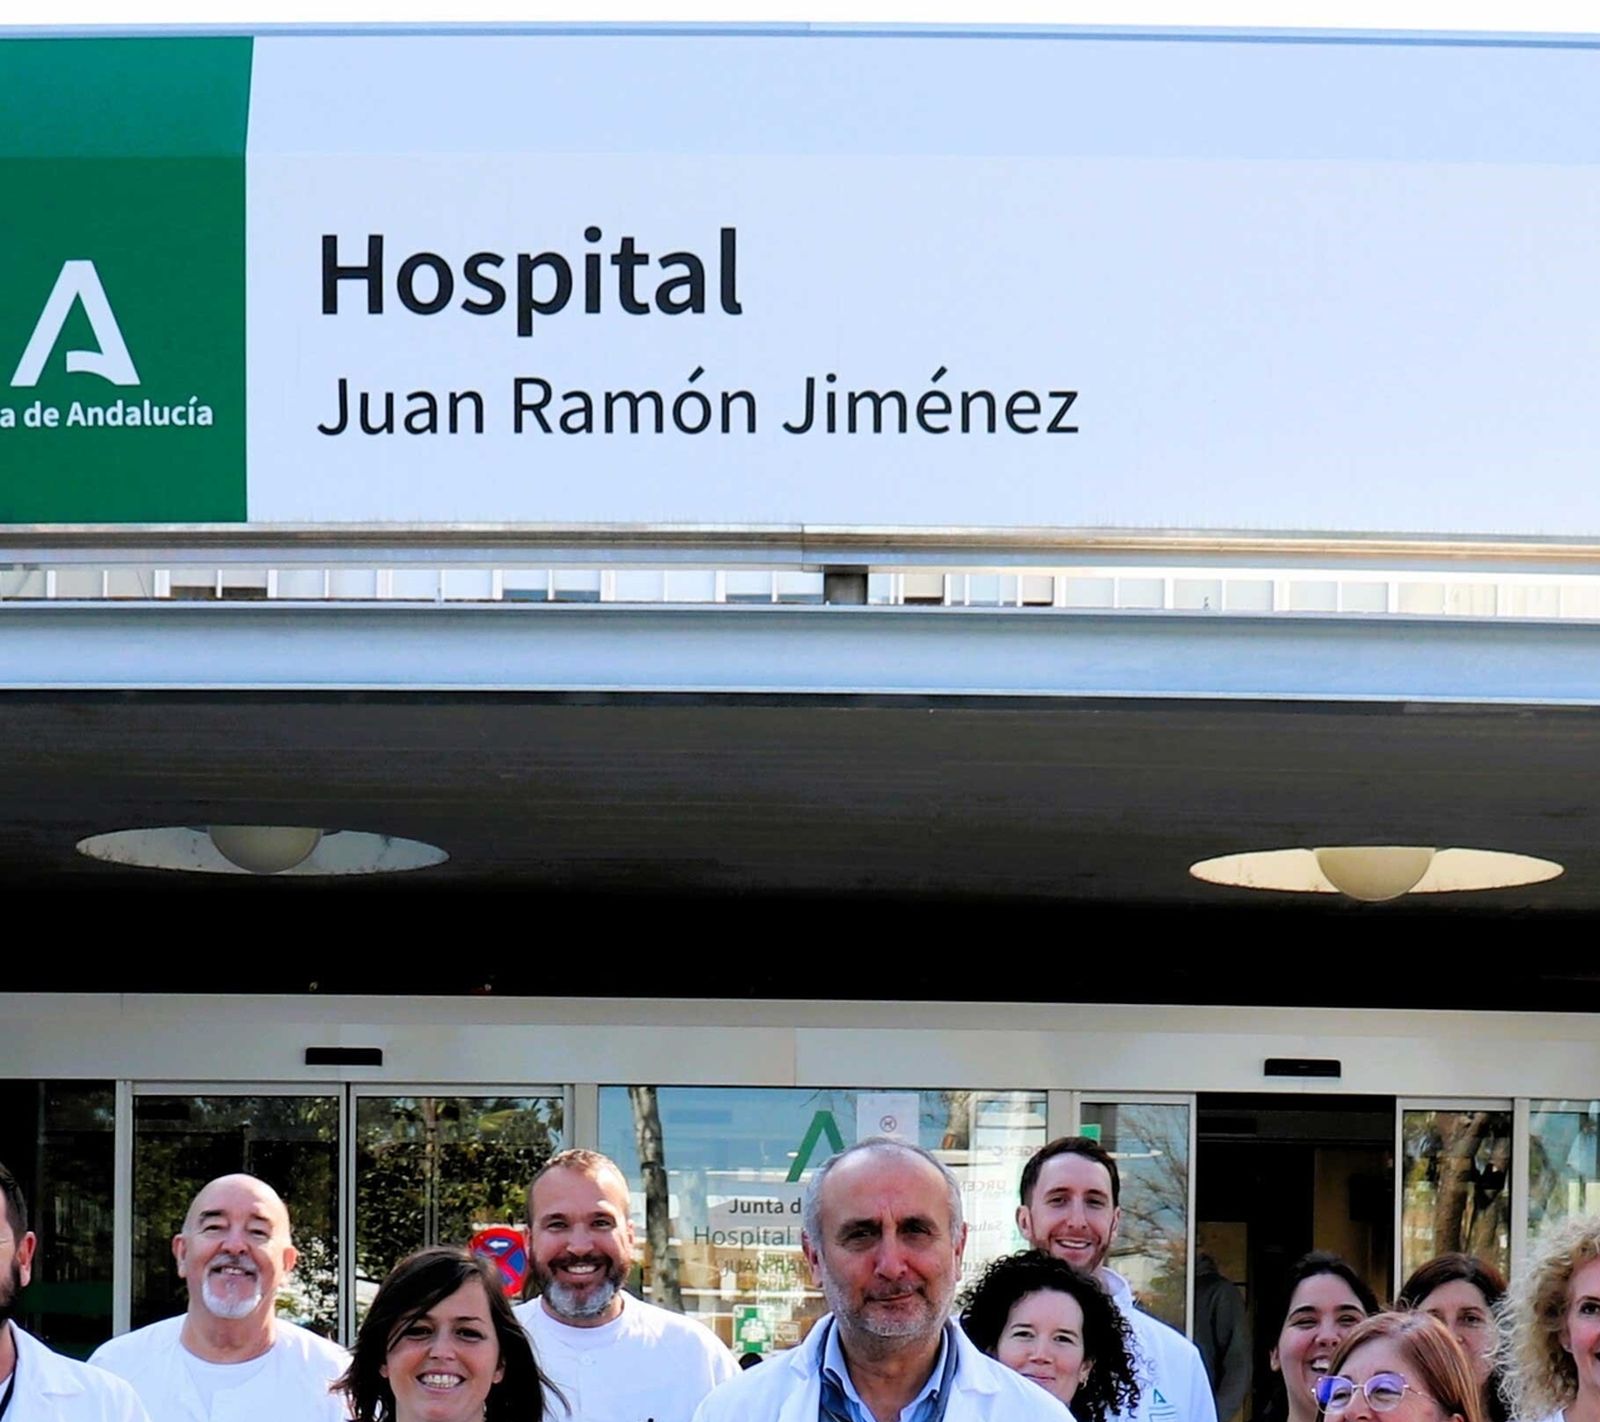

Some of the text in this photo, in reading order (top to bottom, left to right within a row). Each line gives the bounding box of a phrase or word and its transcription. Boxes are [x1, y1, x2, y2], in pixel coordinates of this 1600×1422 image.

[321, 225, 743, 338] Hospital
[23, 400, 60, 428] de
[66, 395, 213, 427] Andalucía
[317, 365, 1079, 436] Juan Ramón Jiménez
[728, 1197, 802, 1214] Junta d
[693, 1225, 791, 1252] Hospital
